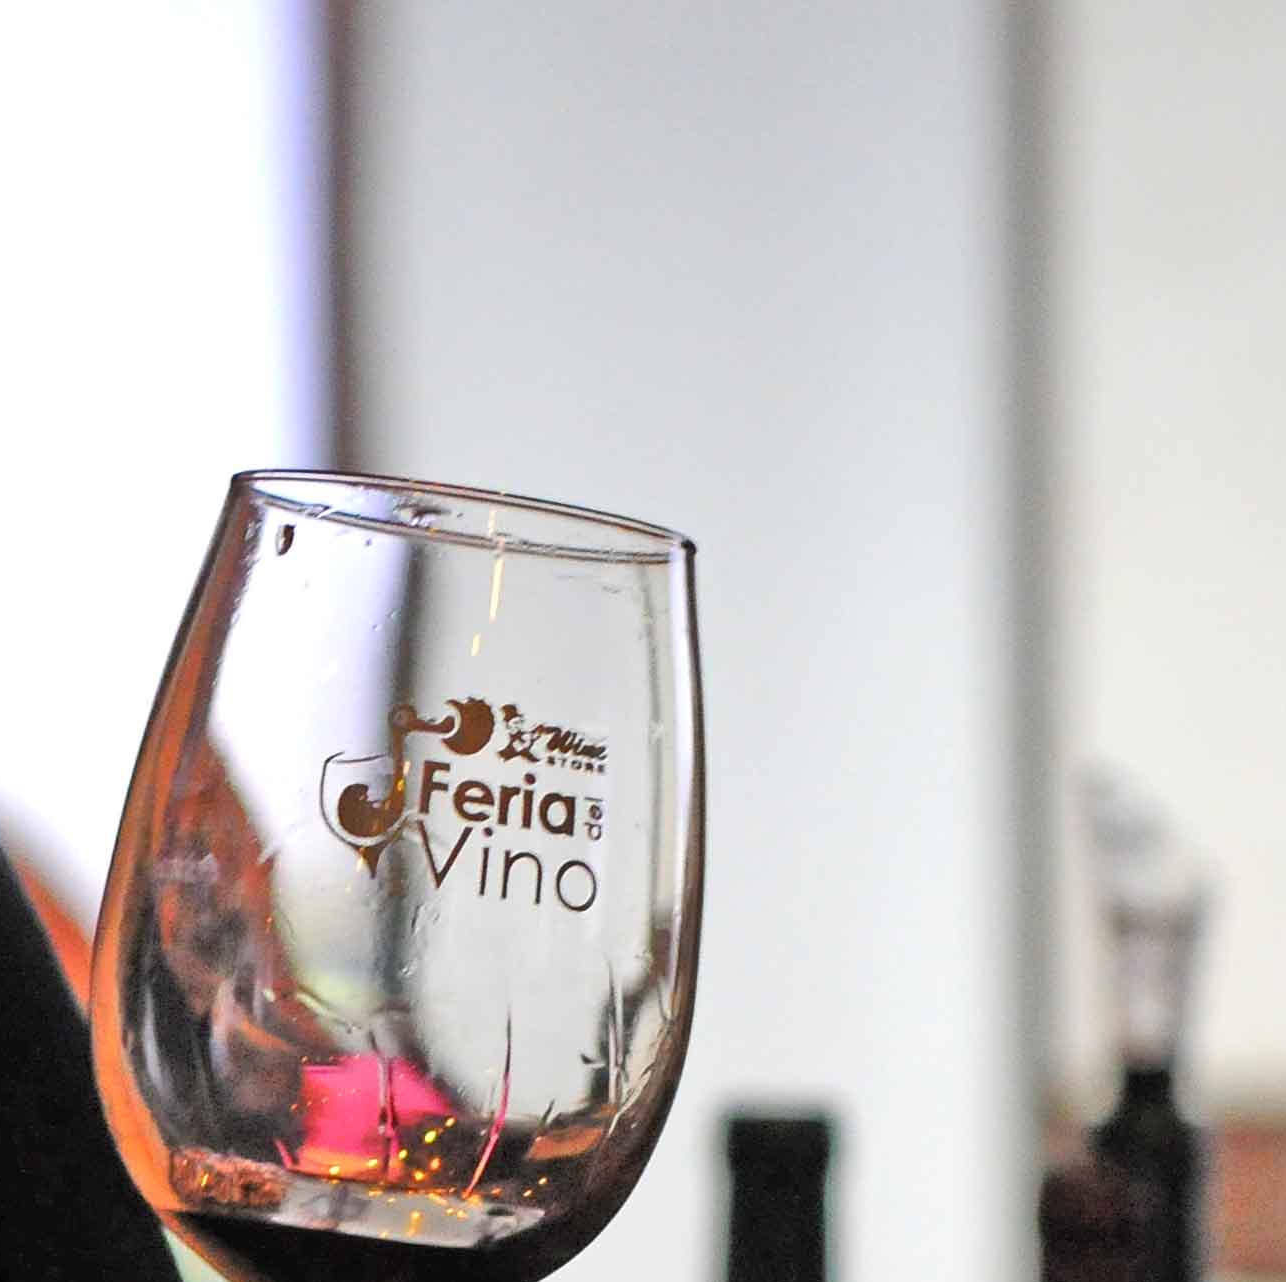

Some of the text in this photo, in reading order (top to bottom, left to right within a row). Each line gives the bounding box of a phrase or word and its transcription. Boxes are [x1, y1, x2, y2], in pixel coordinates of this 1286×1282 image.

[546, 757, 606, 773] STORE
[419, 761, 576, 836] Feria
[585, 797, 603, 840] del
[419, 821, 597, 911] Vino
